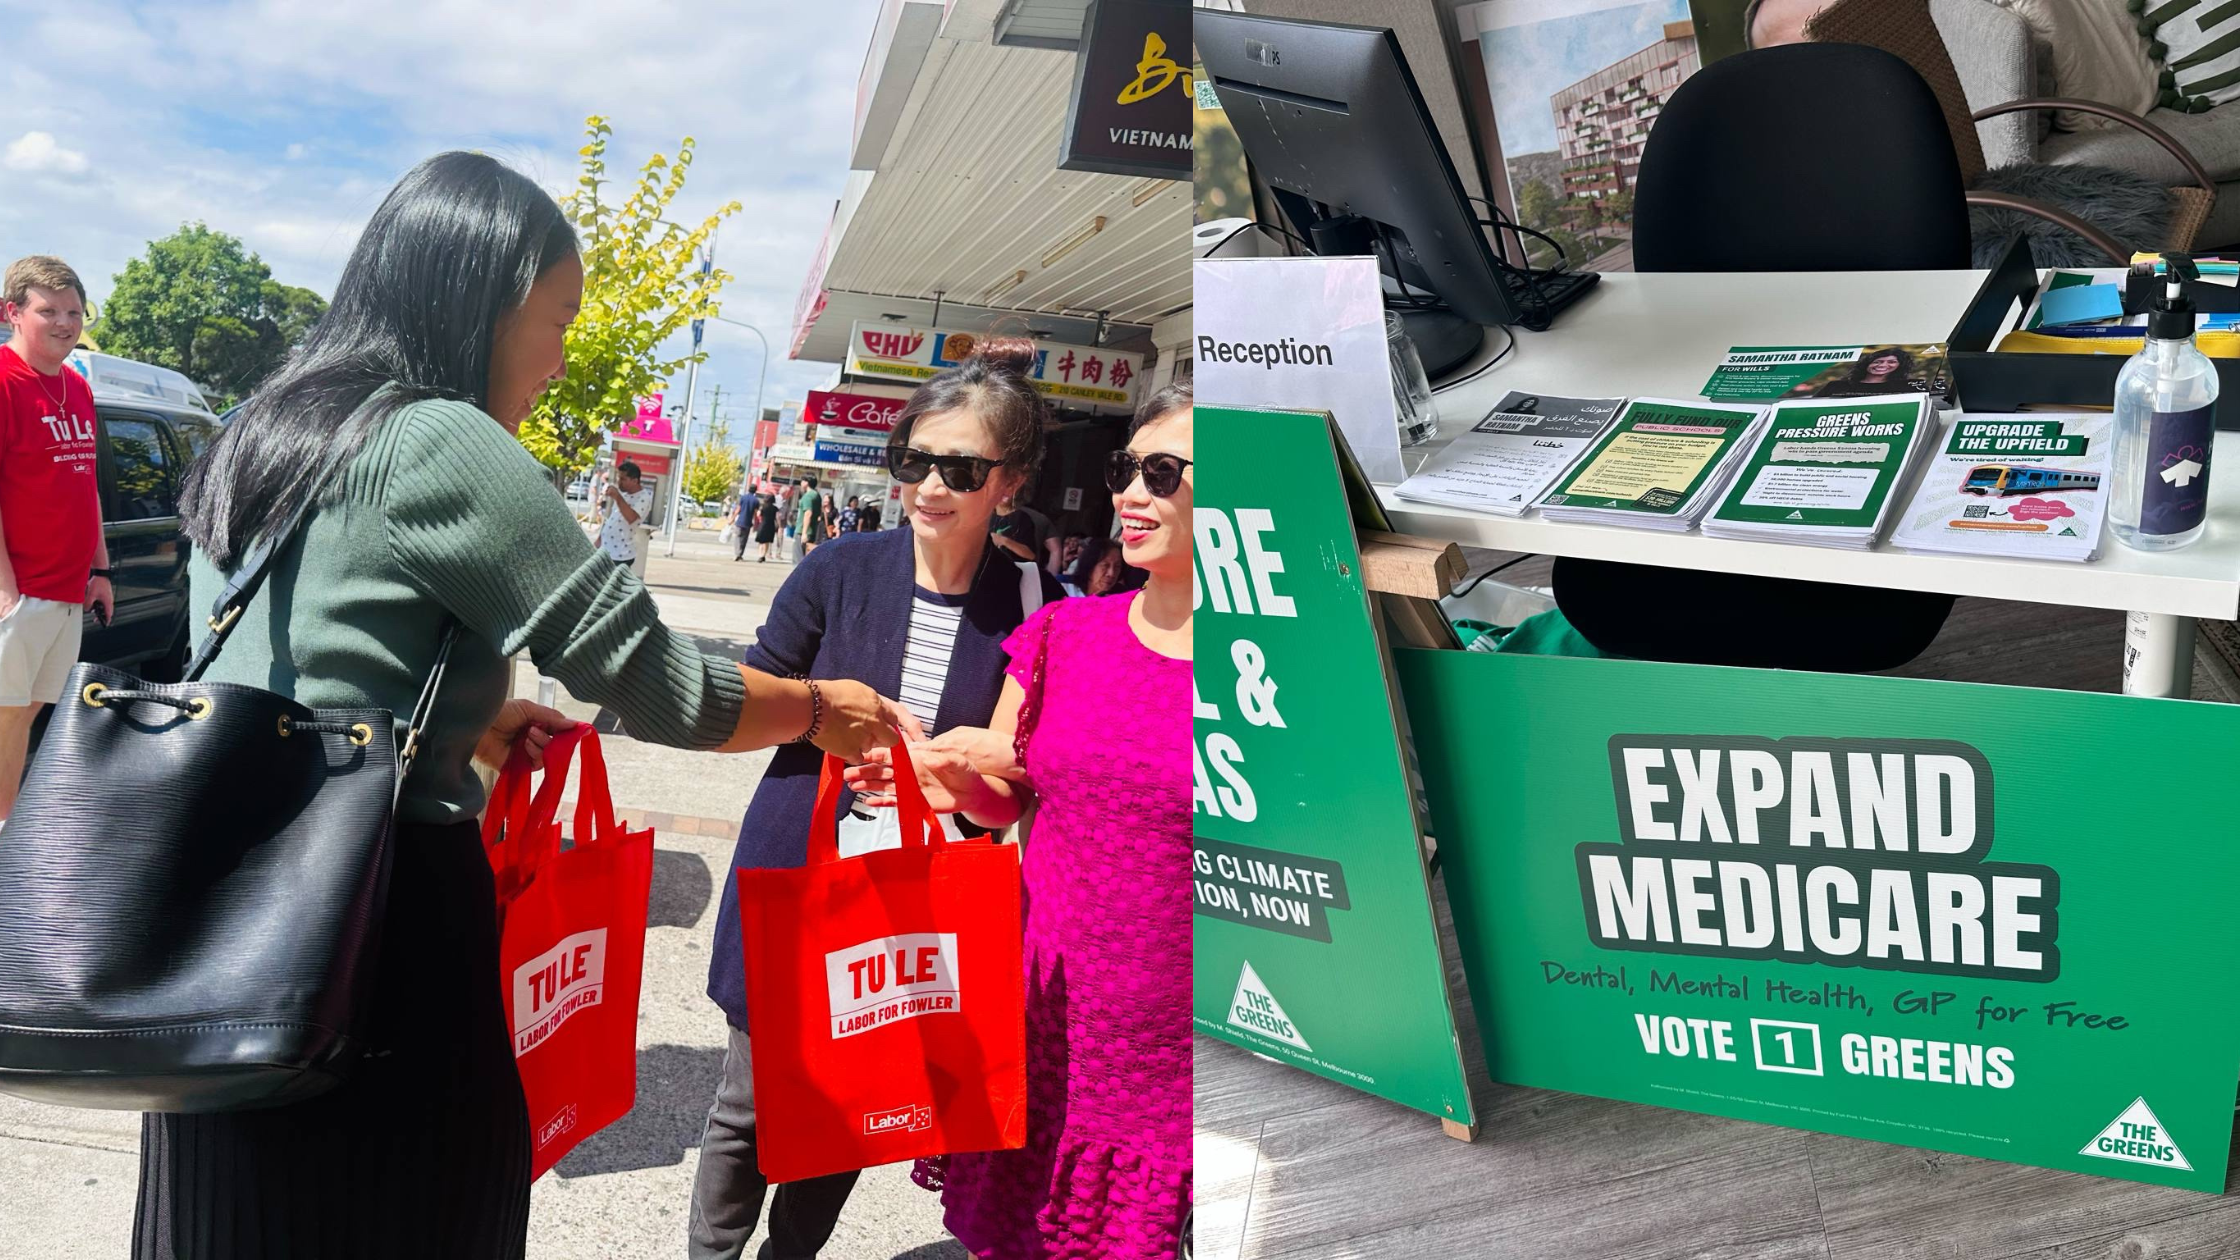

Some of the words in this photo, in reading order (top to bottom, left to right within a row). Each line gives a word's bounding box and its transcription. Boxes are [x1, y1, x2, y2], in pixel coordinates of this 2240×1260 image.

[1197, 335, 1334, 370] Reception
[1728, 353, 1796, 363] SAMANTHA
[1799, 351, 1854, 361] RATNAM
[860, 361, 913, 377] Vietnamese
[1058, 349, 1134, 388] 牛肉粉
[1070, 387, 1095, 397] CANLEY
[1097, 391, 1113, 400] VALE
[41, 415, 72, 442] Tu
[71, 414, 95, 440] Le
[1484, 421, 1521, 430] RATNAM
[1492, 414, 1539, 424] SAMANTHA
[1631, 411, 1673, 425] FULLY
[1673, 415, 1711, 427] FUND
[1713, 418, 1742, 429] OUR
[1635, 424, 1670, 432] PUBLIC
[1775, 426, 1848, 439] PRESSURE
[1851, 423, 1905, 437] WORKS
[1816, 412, 1871, 428] GREENS
[1962, 424, 2045, 437] UPGRADE
[820, 443, 867, 456] WHOLESALE
[1958, 437, 1992, 450] THE
[1994, 438, 2069, 451] UPFIELD
[1193, 508, 1298, 618] RE
[1230, 639, 1287, 728] &
[1621, 747, 1976, 855] EXPAND
[1216, 854, 1333, 899] CLIMATE
[1250, 892, 1311, 927] NOW
[1588, 854, 2043, 971] MEDICARE
[529, 961, 557, 1014] TU
[560, 944, 592, 991] LE
[848, 953, 886, 1000] TU
[896, 947, 939, 986] LE
[1243, 989, 1274, 1015] THE
[1540, 959, 1635, 995] Dental,
[1649, 970, 1749, 1001] Mental
[1765, 977, 1875, 1017] Health,
[1893, 989, 1957, 1016] GP
[1975, 995, 2028, 1031] for
[2045, 1000, 2130, 1032] Free
[520, 1022, 549, 1051] LABOR
[562, 990, 597, 1018] FOWLER
[838, 1011, 876, 1034] LABOR
[878, 1004, 898, 1022] FOR
[901, 996, 953, 1015] FOWLER
[1235, 1004, 1294, 1039] GREENS
[1208, 1021, 1216, 1030] by
[1246, 1034, 1257, 1044] The
[1291, 1049, 1312, 1063] Queen
[1321, 1061, 1356, 1078] Melbourne
[1634, 1013, 1736, 1063] VOTE
[1774, 1030, 1797, 1065] 1
[1841, 1033, 2016, 1089] GREENS
[541, 1115, 565, 1144] Labor
[869, 1112, 911, 1130] Labor
[2119, 1121, 2157, 1143] THE
[2097, 1136, 2175, 1163] GREENS
